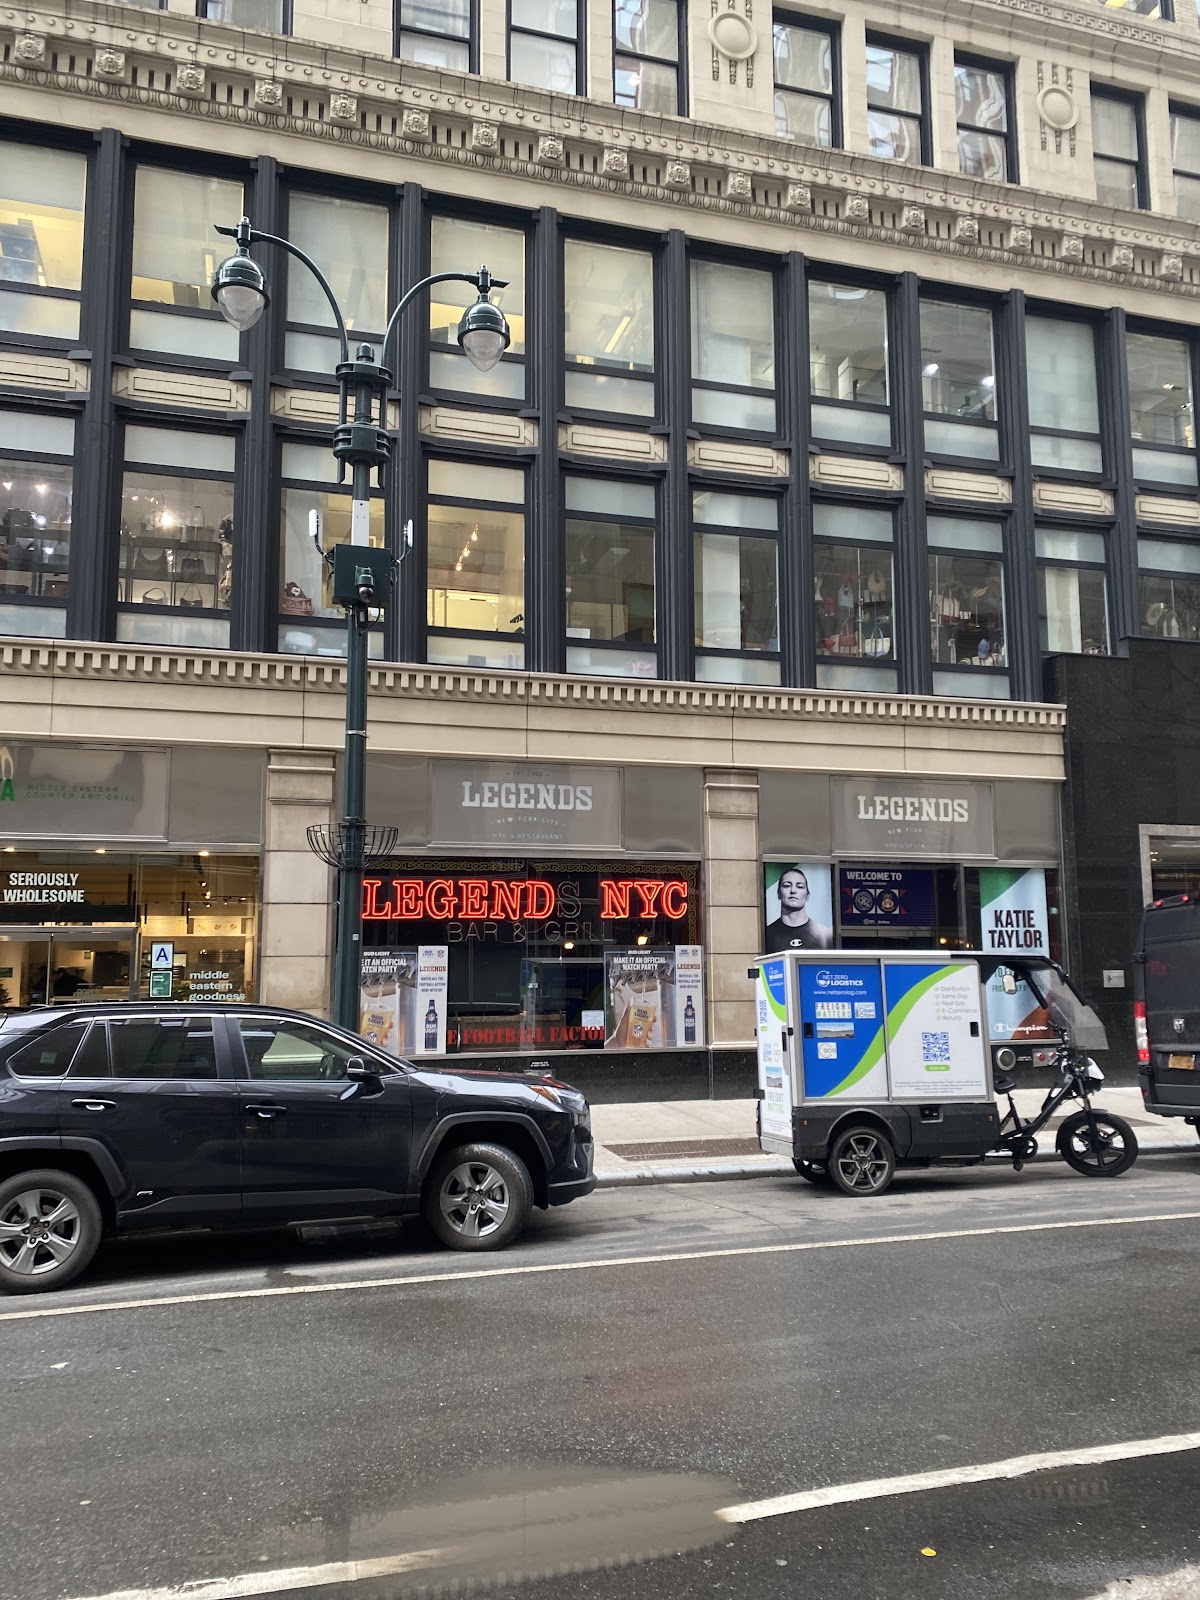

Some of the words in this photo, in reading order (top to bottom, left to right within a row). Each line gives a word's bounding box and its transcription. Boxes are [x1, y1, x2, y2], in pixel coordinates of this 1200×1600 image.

[0, 778, 15, 801] A
[26, 784, 66, 792] MIDDLE
[72, 785, 119, 793] EASTERN
[461, 781, 593, 811] LEGENDS
[857, 795, 969, 823] LEGENDS
[8, 872, 79, 886] SERIOUSLY
[846, 871, 890, 880] WELCOME
[890, 872, 902, 881] TO
[3, 889, 85, 902] WHOLESOME
[361, 878, 582, 920] LEGENDS
[600, 879, 688, 920] NYC
[994, 909, 1035, 928] KATIE
[448, 921, 498, 943] BAR
[513, 922, 527, 943] &
[988, 929, 1043, 948] TAYLOR
[155, 947, 169, 961] A
[613, 956, 629, 964] MAKE
[629, 956, 635, 964] IT
[635, 956, 643, 964] AN
[643, 956, 666, 964] OFFICIAL
[365, 958, 371, 966] IT
[371, 958, 380, 966] AN
[381, 958, 408, 966] OFFICIAL
[641, 963, 658, 971] PARTY
[189, 970, 229, 980] middle
[189, 982, 233, 990] eastern
[188, 992, 246, 1002] goodness
[815, 1002, 851, 1010] FREIGHT
[816, 1010, 851, 1018] MATTERS
[367, 1017, 385, 1026] LIGHT
[994, 1022, 1049, 1035] Champion
[462, 1027, 545, 1045] FOOTBALL
